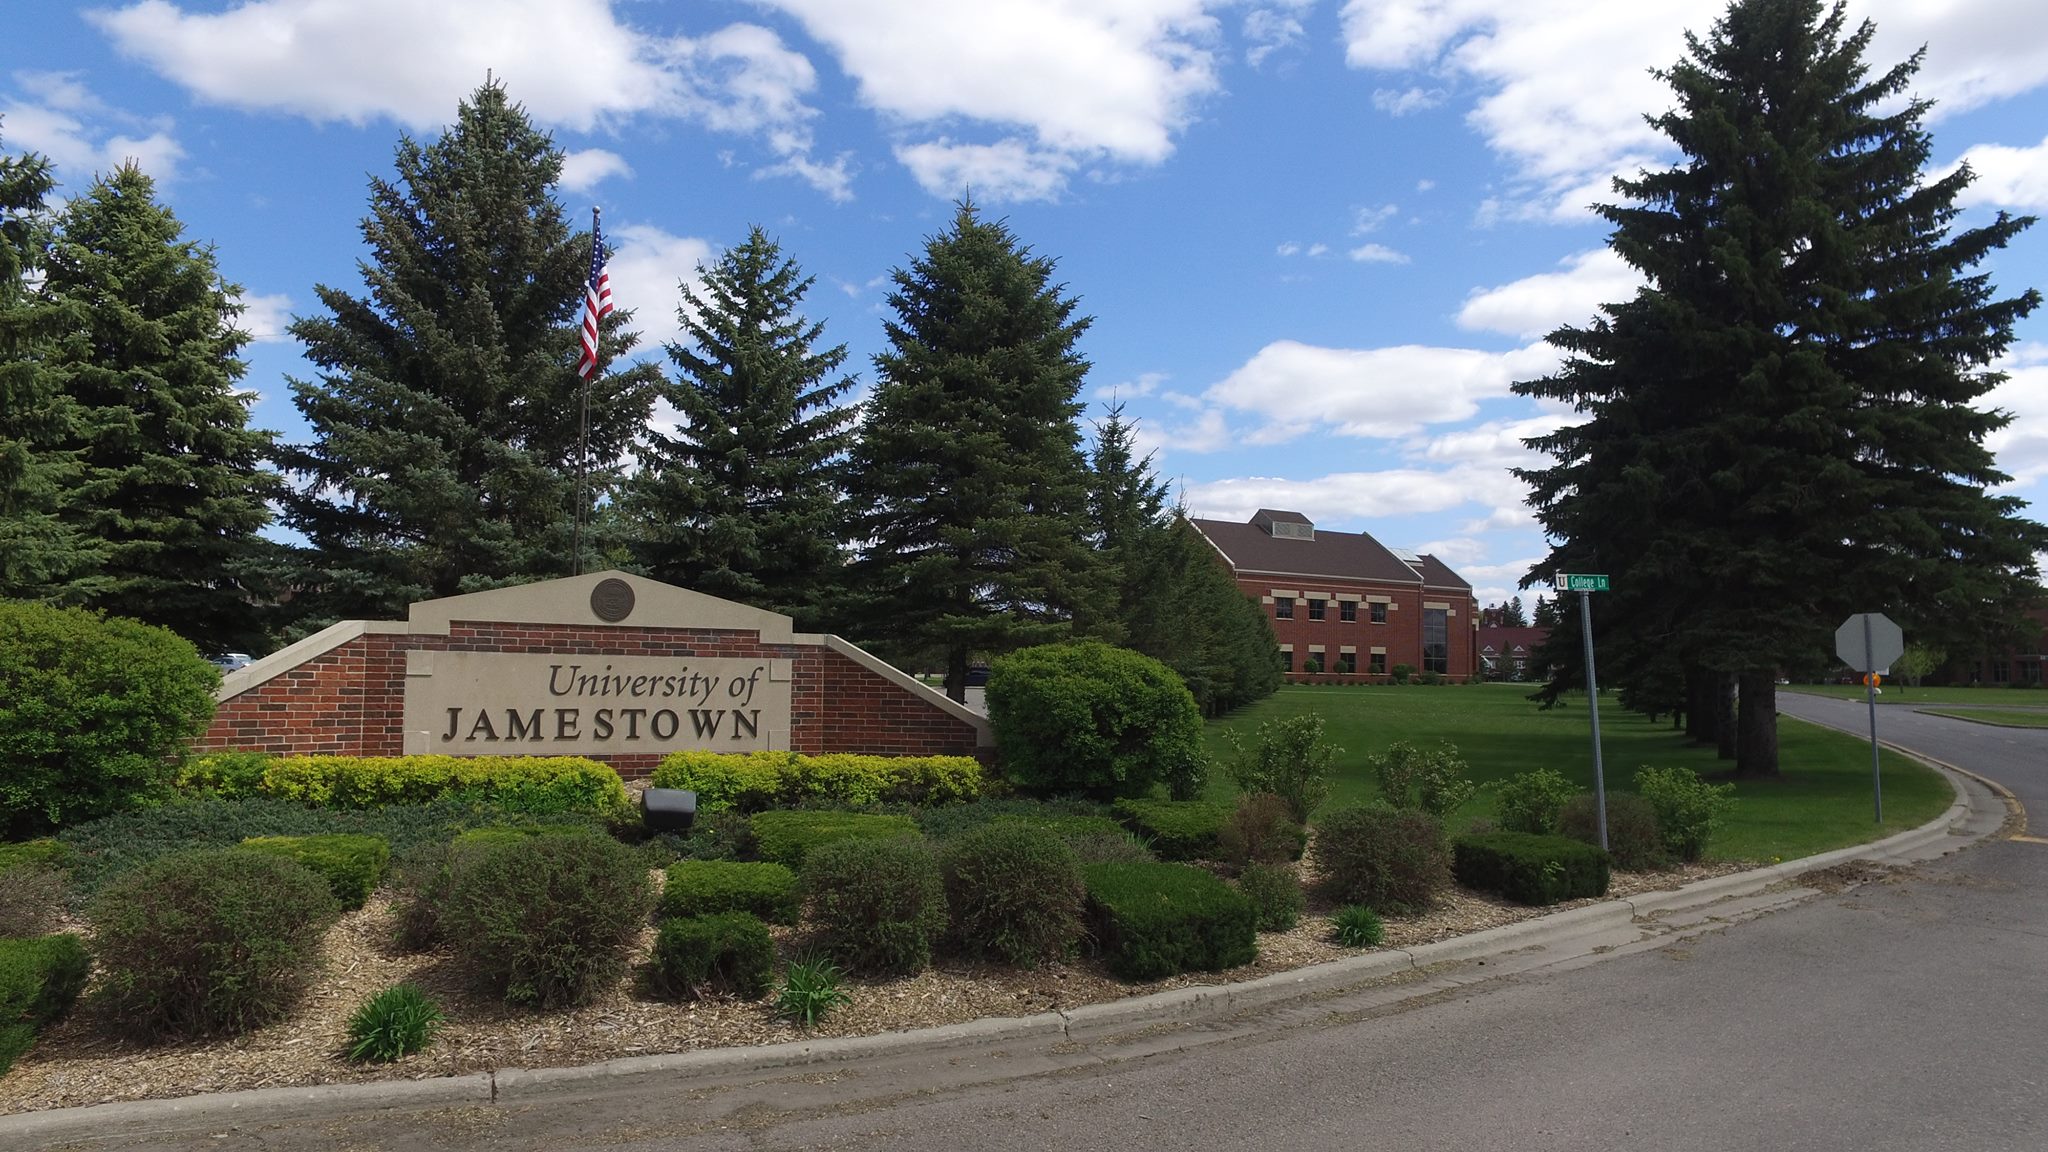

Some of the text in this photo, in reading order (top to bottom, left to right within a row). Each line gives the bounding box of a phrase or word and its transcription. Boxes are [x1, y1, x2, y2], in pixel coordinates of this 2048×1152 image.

[1570, 576, 1594, 589] College
[1597, 576, 1606, 588] Ln
[548, 664, 764, 706] University of
[442, 706, 762, 742] JAMESTOWN
